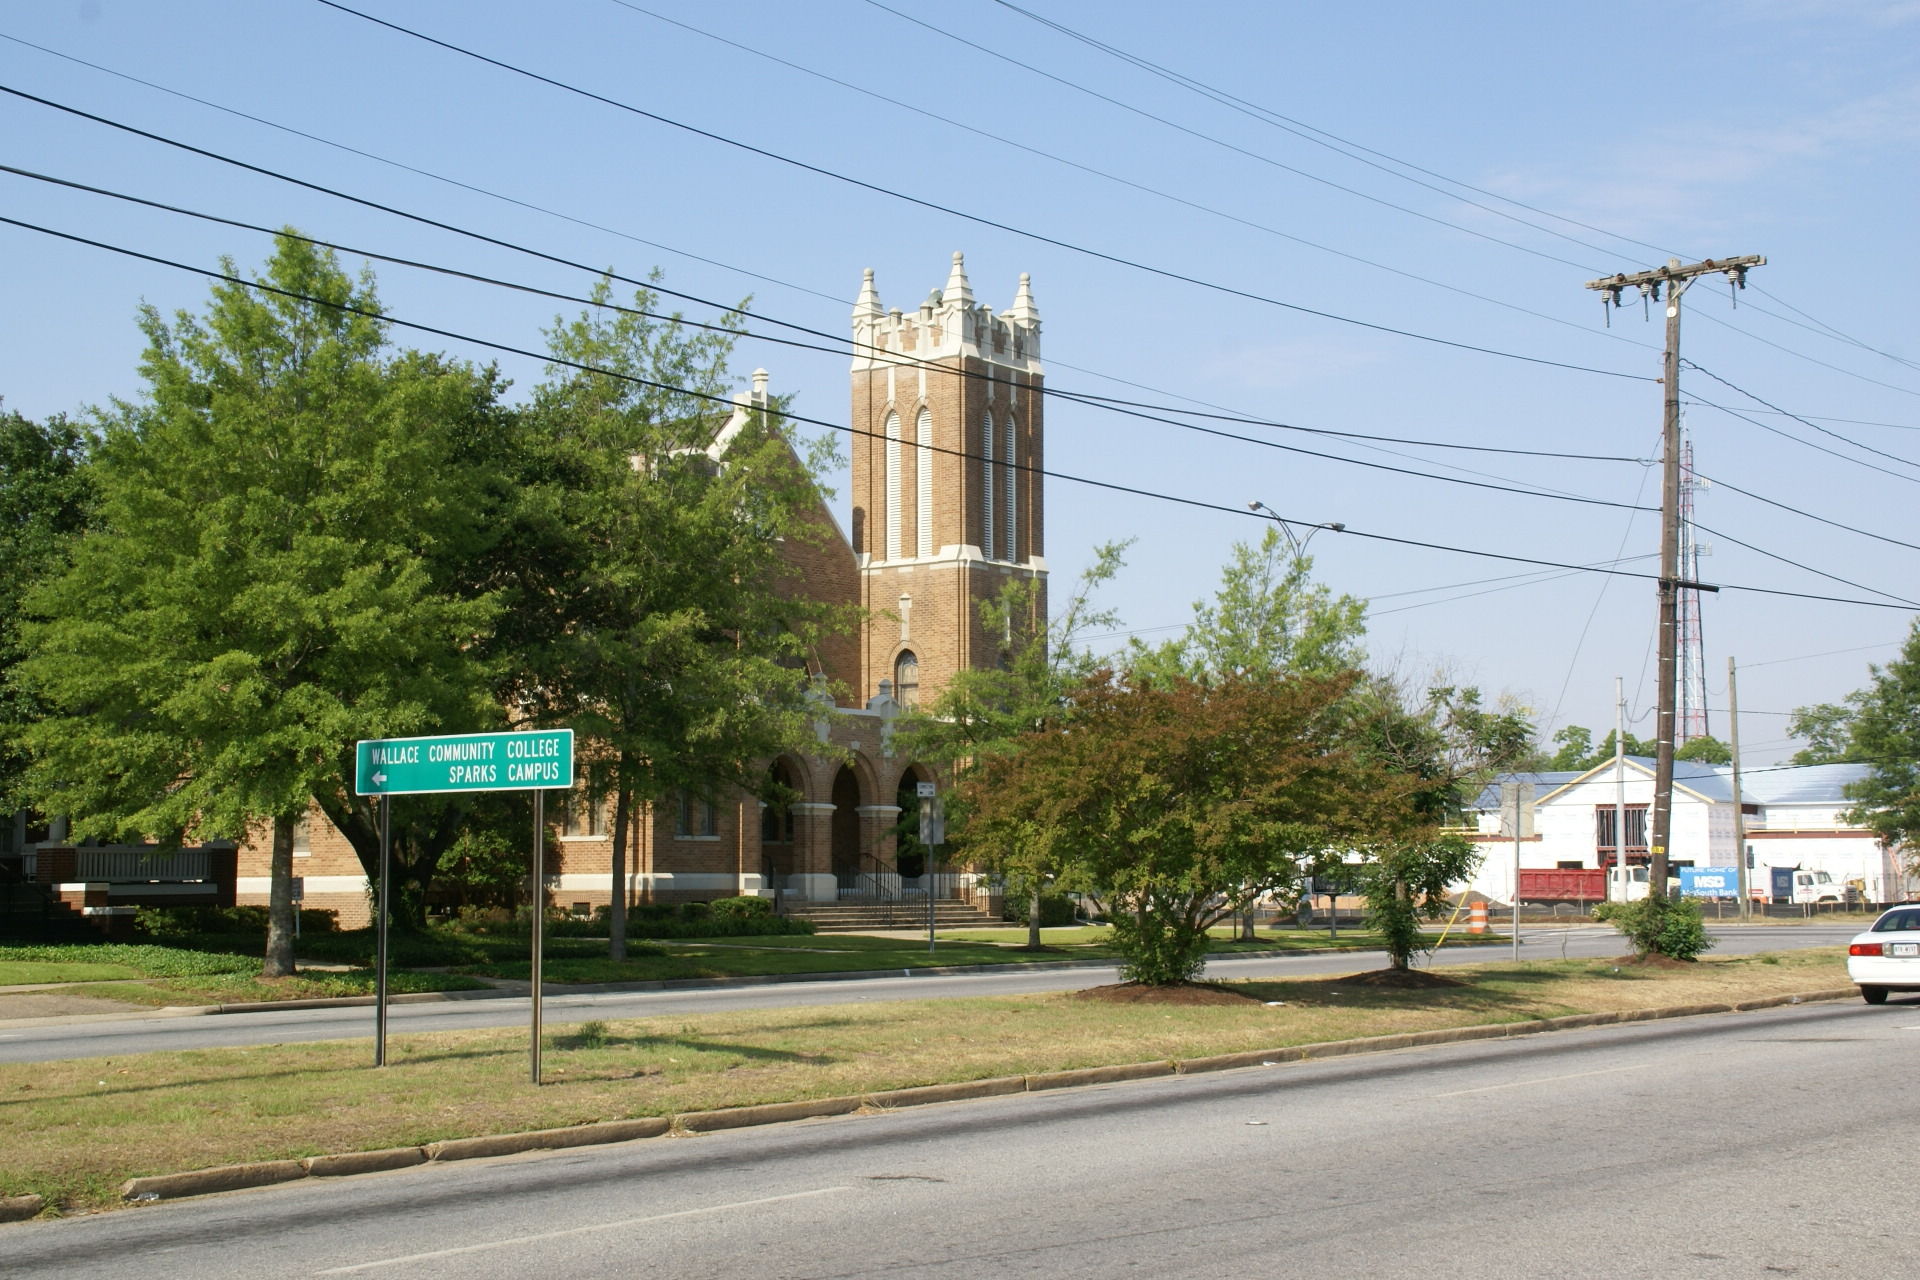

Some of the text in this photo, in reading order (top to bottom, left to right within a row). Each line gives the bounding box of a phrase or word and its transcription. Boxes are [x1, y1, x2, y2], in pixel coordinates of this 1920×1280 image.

[372, 738, 560, 765] WALLACE COMMUNITY COLLEGE
[449, 762, 559, 784] SPARKS CAMPUS
[1694, 876, 1725, 888] MSB
[1719, 888, 1738, 897] Bank
